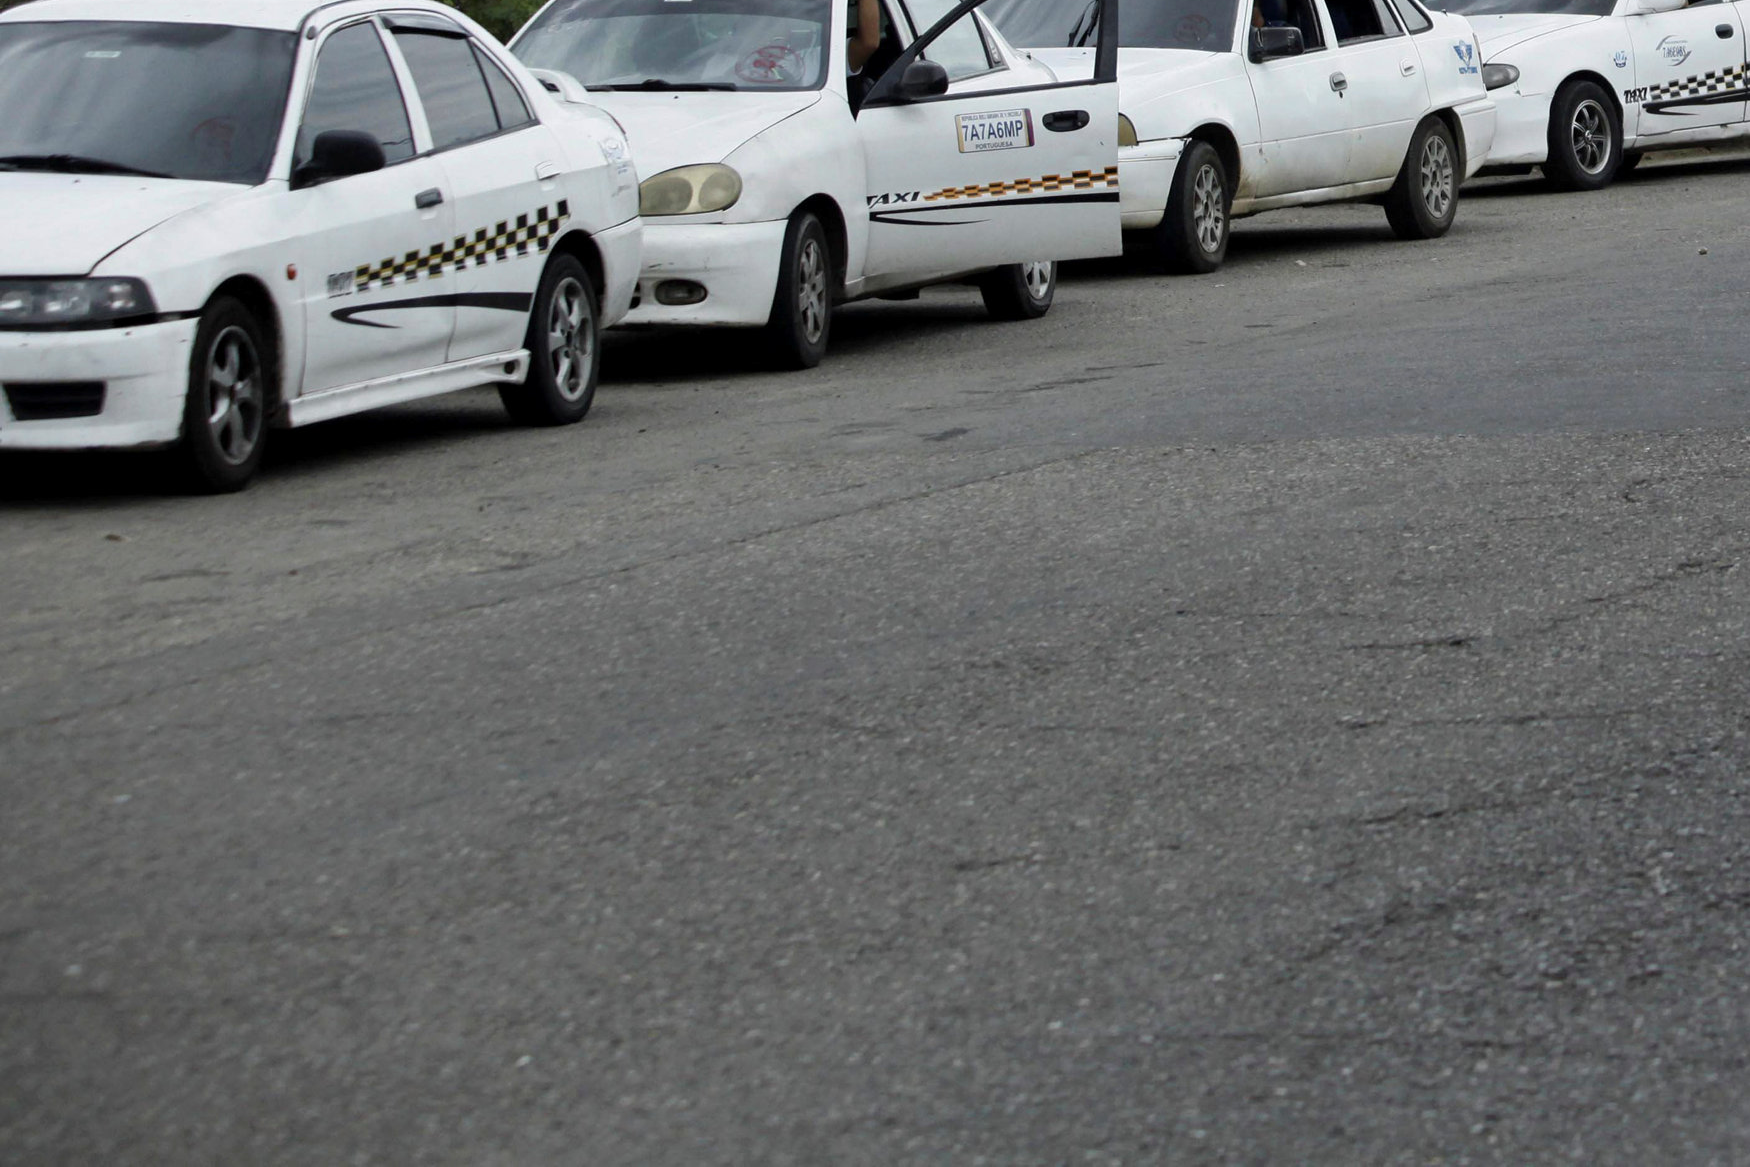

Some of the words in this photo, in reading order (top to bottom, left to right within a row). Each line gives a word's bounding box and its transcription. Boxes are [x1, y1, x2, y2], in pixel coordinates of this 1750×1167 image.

[1623, 87, 1648, 104] TAXI
[961, 119, 1023, 141] 7A7A6MP
[975, 141, 1014, 150] PORTUGUESA
[866, 191, 920, 210] TAXI
